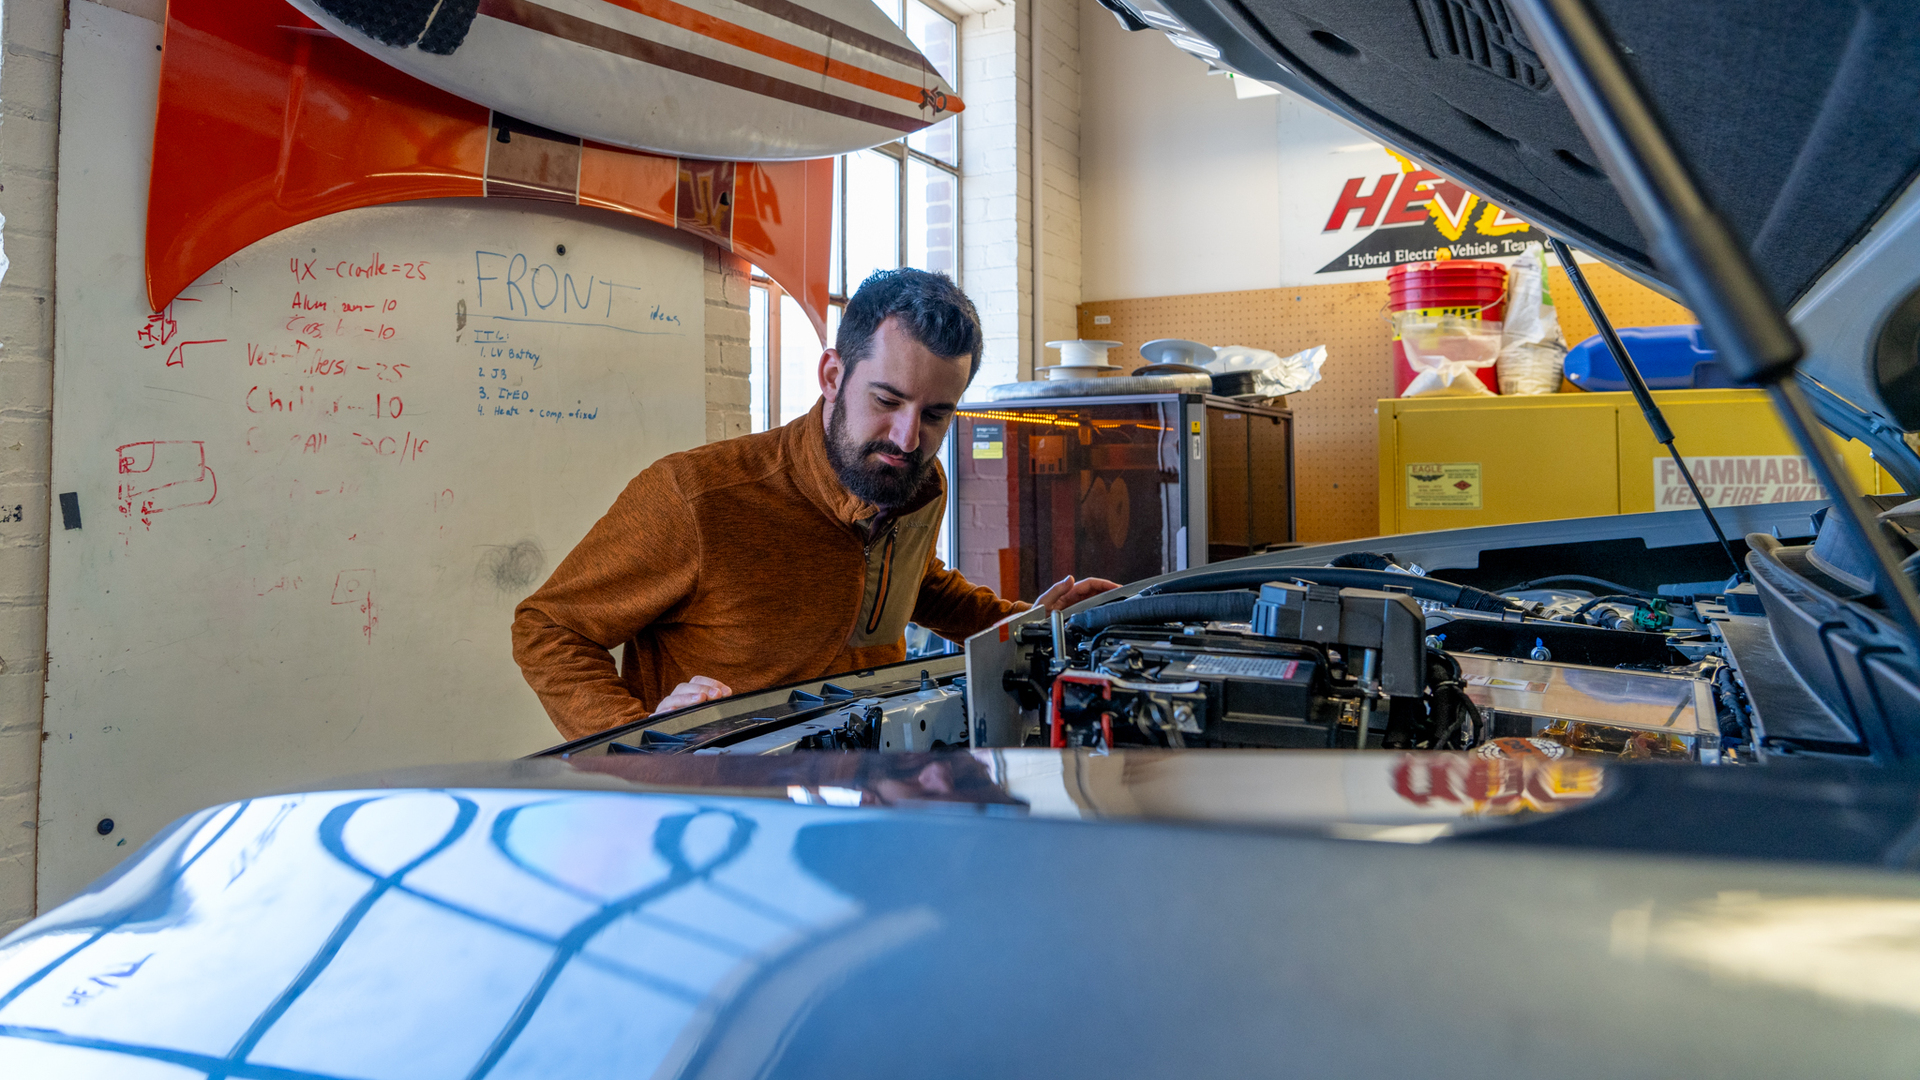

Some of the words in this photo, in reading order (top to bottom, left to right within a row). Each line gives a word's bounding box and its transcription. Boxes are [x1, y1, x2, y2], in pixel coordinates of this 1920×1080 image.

[1322, 149, 1531, 242] HEV
[1347, 252, 1391, 268] Hybrid
[1395, 247, 1445, 263] Electri
[1449, 241, 1498, 257] Vehicle
[475, 250, 642, 317] FRONT
[508, 348, 541, 367] Battery
[478, 386, 490, 400] 3.
[477, 403, 485, 416] 4.
[1412, 464, 1442, 473] EAGLE
[1660, 458, 1823, 485] FLAMMABL
[1661, 486, 1715, 506] KEEP
[1718, 485, 1768, 505] FIRE
